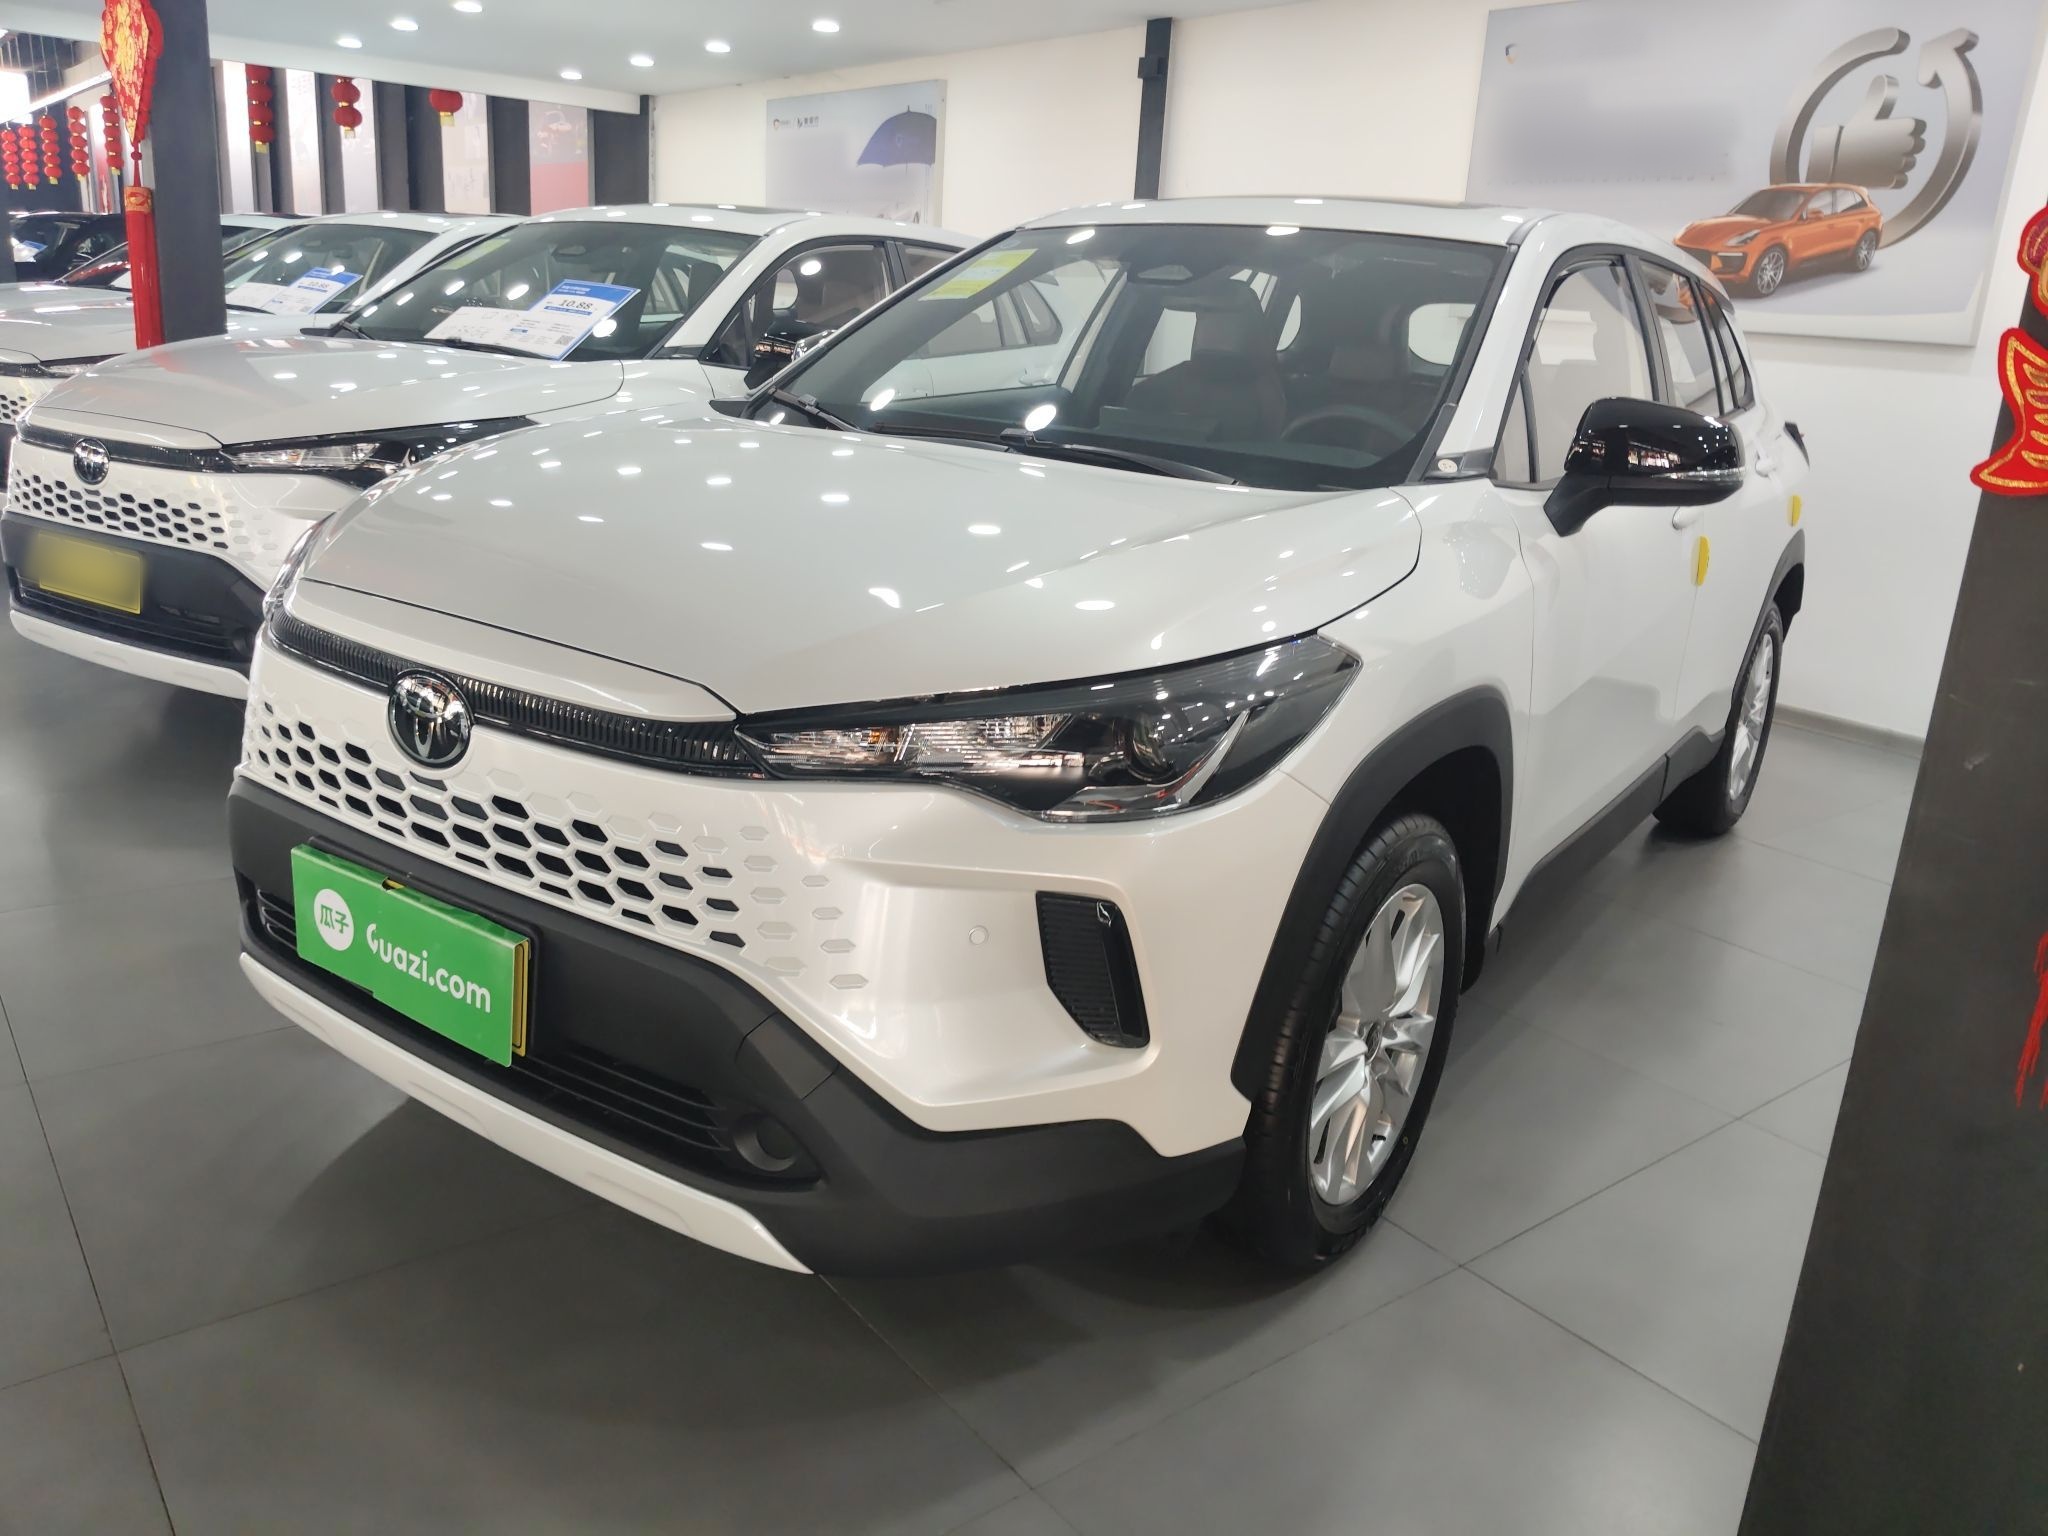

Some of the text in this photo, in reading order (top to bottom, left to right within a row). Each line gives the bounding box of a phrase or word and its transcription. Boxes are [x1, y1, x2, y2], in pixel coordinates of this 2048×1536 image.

[559, 299, 593, 310] 10.88
[320, 904, 349, 934] 瓜子
[366, 923, 491, 1013] Guazi.com
